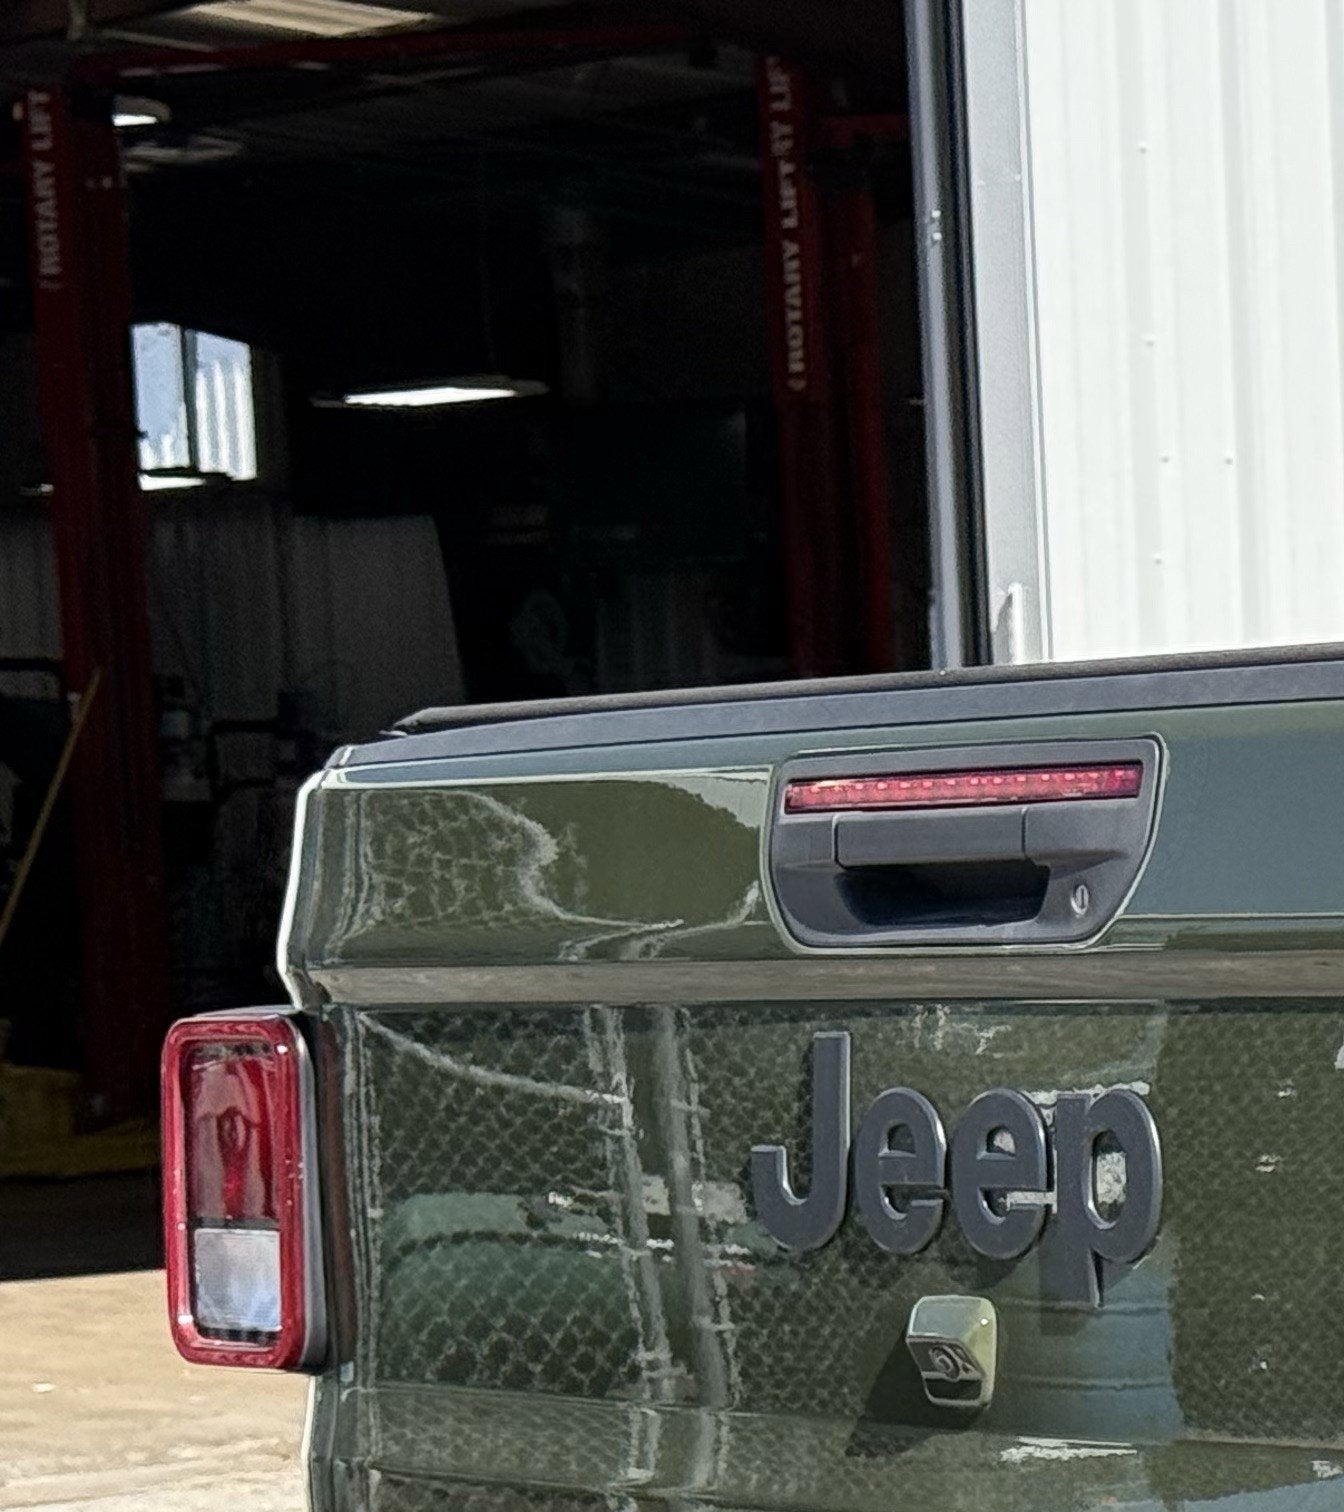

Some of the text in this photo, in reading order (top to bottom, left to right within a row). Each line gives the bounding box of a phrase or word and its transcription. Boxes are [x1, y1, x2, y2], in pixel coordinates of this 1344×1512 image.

[26, 89, 61, 278] ROTARY LIFT
[777, 160, 800, 230] LIFT
[781, 238, 806, 375] ROTARY
[750, 1030, 1164, 1308] Jeep
